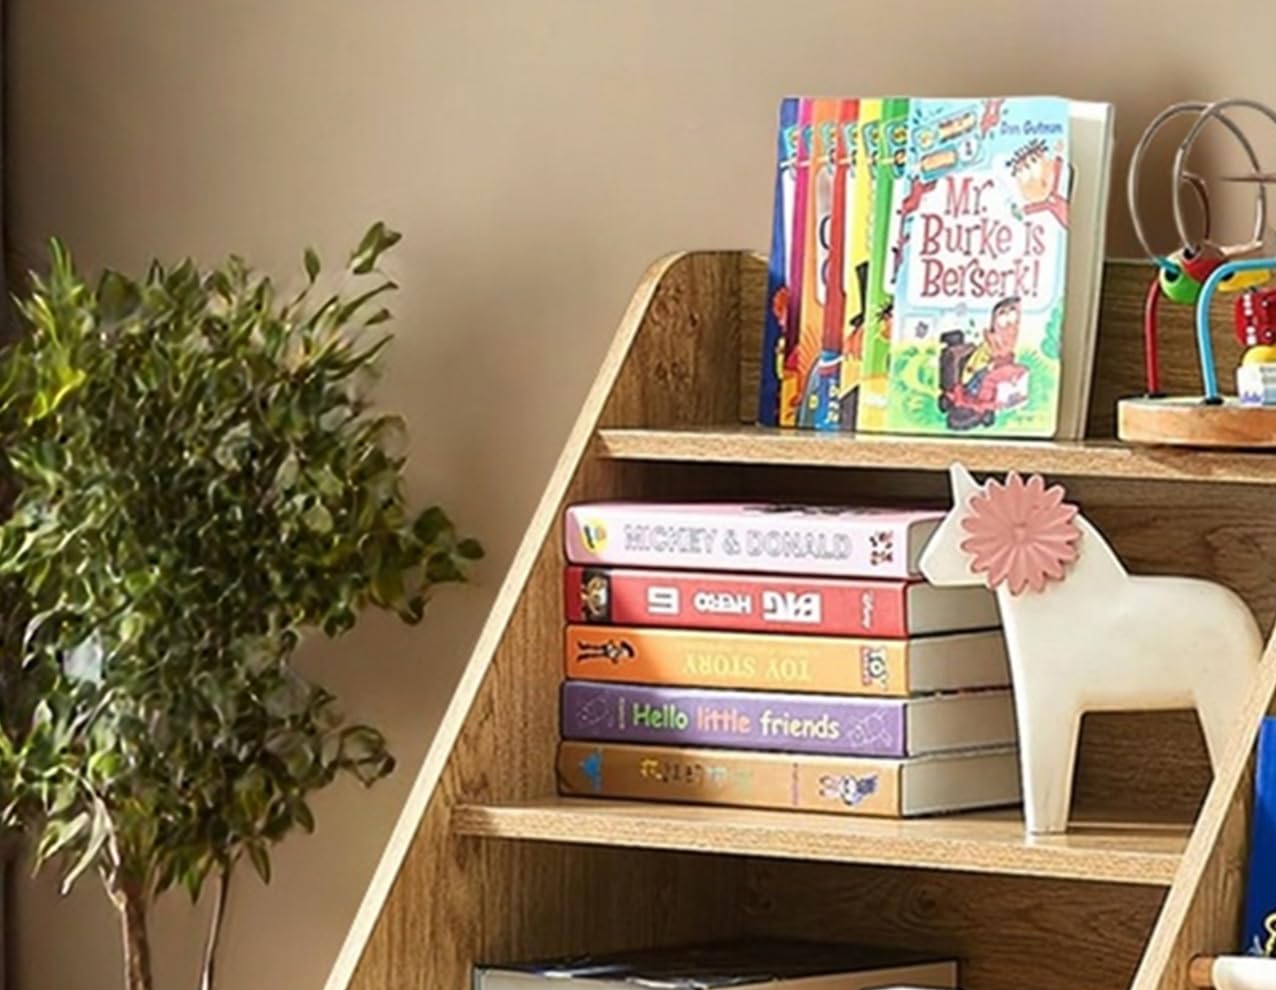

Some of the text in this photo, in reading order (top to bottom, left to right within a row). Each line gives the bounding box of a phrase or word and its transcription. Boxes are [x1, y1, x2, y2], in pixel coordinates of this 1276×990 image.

[944, 175, 995, 218] Mr.
[919, 213, 1013, 260] Burke
[920, 258, 1039, 298] Berserk!
[624, 523, 852, 560] MICKEY & DONALD
[694, 590, 752, 615] HERO
[762, 590, 822, 624] BIG
[683, 651, 811, 681] TOY STORY
[632, 702, 689, 730] Hello
[696, 706, 751, 733] little
[759, 710, 841, 740] friends
